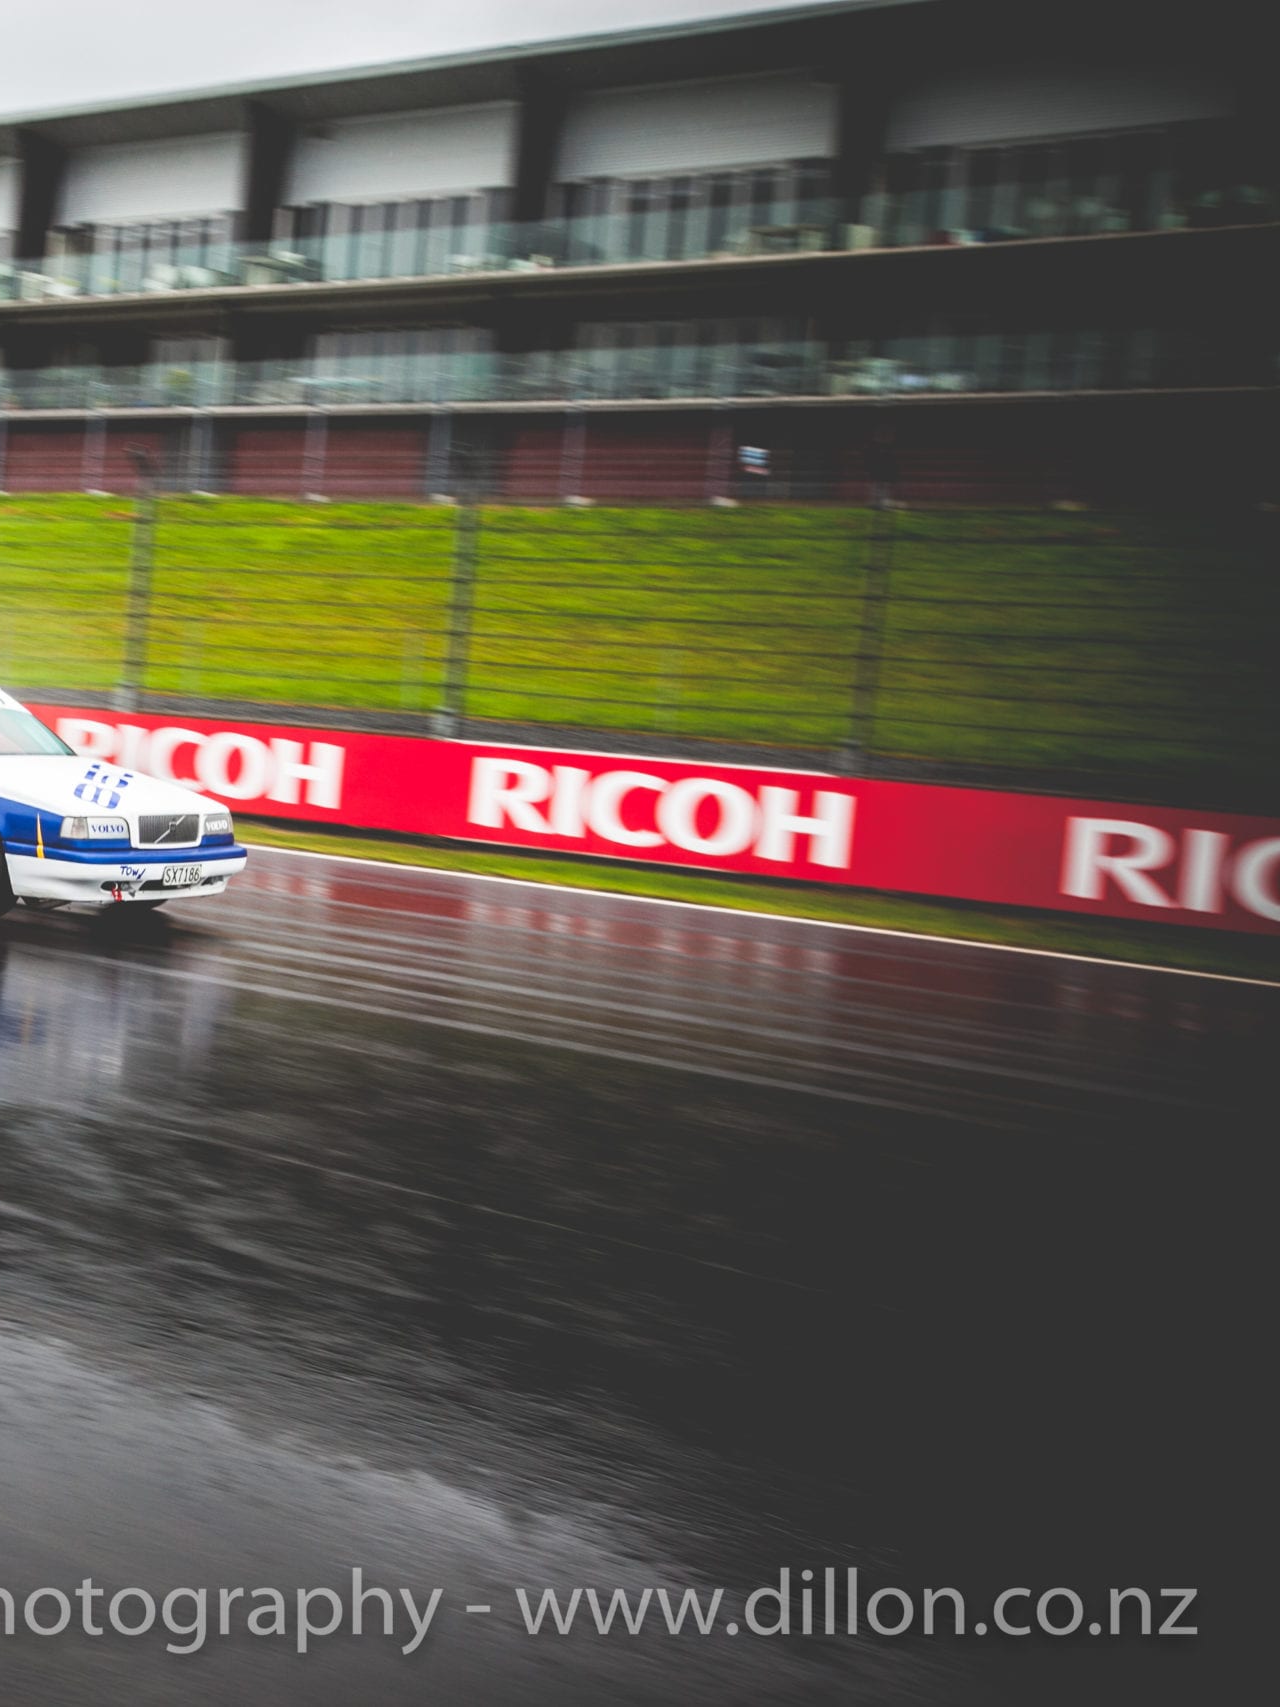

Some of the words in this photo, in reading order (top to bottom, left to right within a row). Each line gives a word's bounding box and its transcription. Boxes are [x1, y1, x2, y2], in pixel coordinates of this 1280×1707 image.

[57, 717, 345, 810] RICOH
[467, 756, 856, 869] RICOH
[91, 824, 124, 834] VOLVO
[205, 819, 228, 831] VOLVO
[164, 867, 200, 883] SX7186
